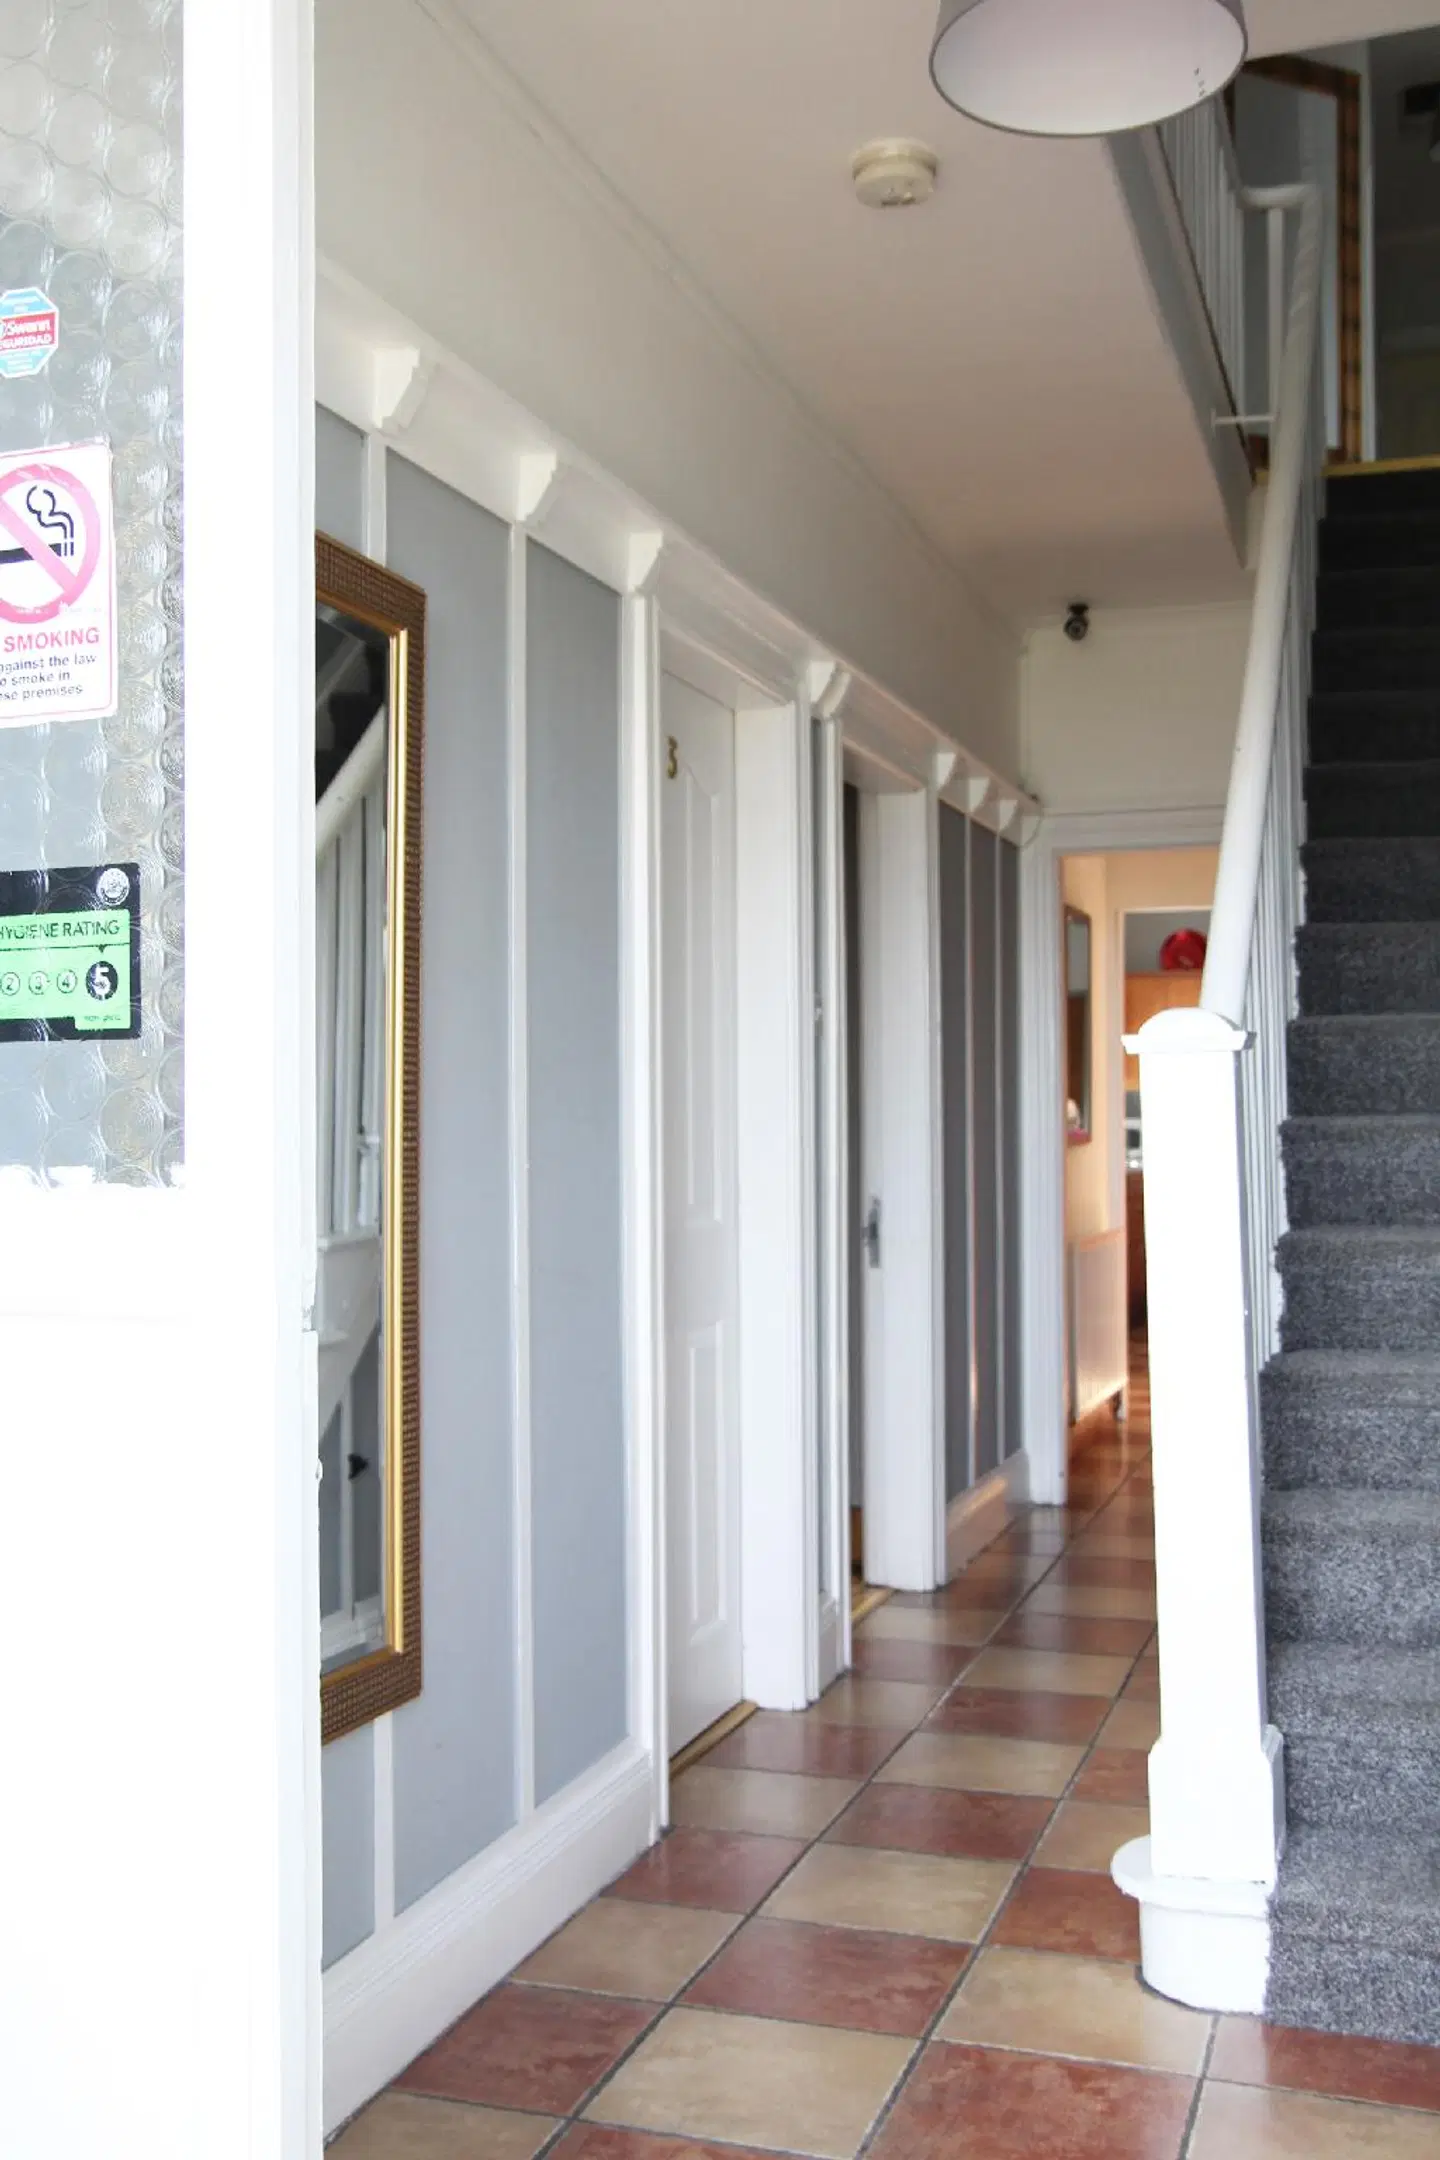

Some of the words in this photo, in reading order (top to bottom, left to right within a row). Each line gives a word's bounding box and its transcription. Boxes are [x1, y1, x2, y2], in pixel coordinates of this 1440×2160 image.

[4, 626, 100, 653] SMOKING
[49, 655, 70, 667] the
[74, 652, 97, 665] law
[11, 672, 54, 686] smoke
[58, 670, 71, 682] in
[23, 684, 84, 702] premises
[667, 735, 679, 780] 3
[63, 919, 120, 938] RATING
[93, 964, 111, 996] 5
